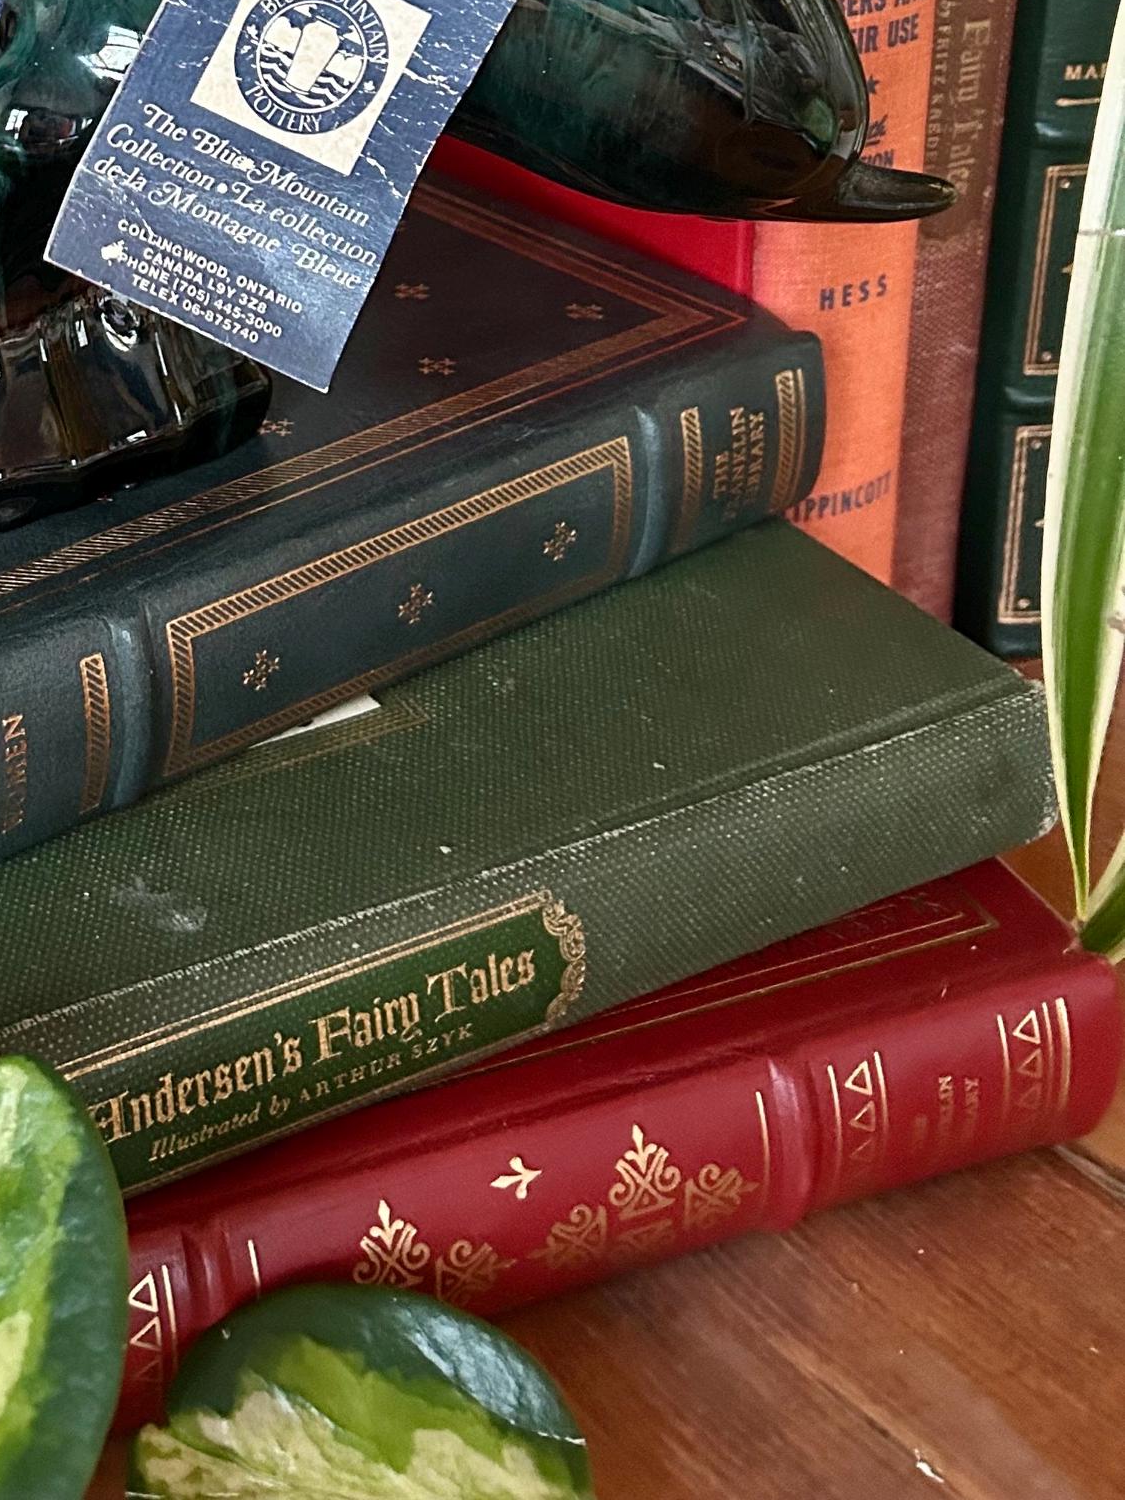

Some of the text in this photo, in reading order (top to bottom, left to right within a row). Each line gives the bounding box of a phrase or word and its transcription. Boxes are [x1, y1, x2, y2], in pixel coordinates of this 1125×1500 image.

[887, 13, 920, 48] USE
[244, 85, 323, 133] POTTERY
[106, 123, 378, 267] Collection La collection
[143, 103, 370, 228] The Blue Mountain
[93, 156, 363, 290] de la Montagne Bleue
[117, 219, 303, 314] COLLINGWOOD, ONTARIO
[117, 253, 283, 338] PHONE (705) 445-3000
[131, 274, 259, 344] TELEX 06-875740
[143, 247, 267, 315] CANADA L9Y 3Z8
[818, 273, 888, 312] HESS
[789, 469, 892, 523] IPPINCOTT
[307, 991, 424, 1067] Fairy
[425, 948, 537, 1024] Tales
[148, 1022, 474, 1163] Illustrated by ARTHUR SZYK
